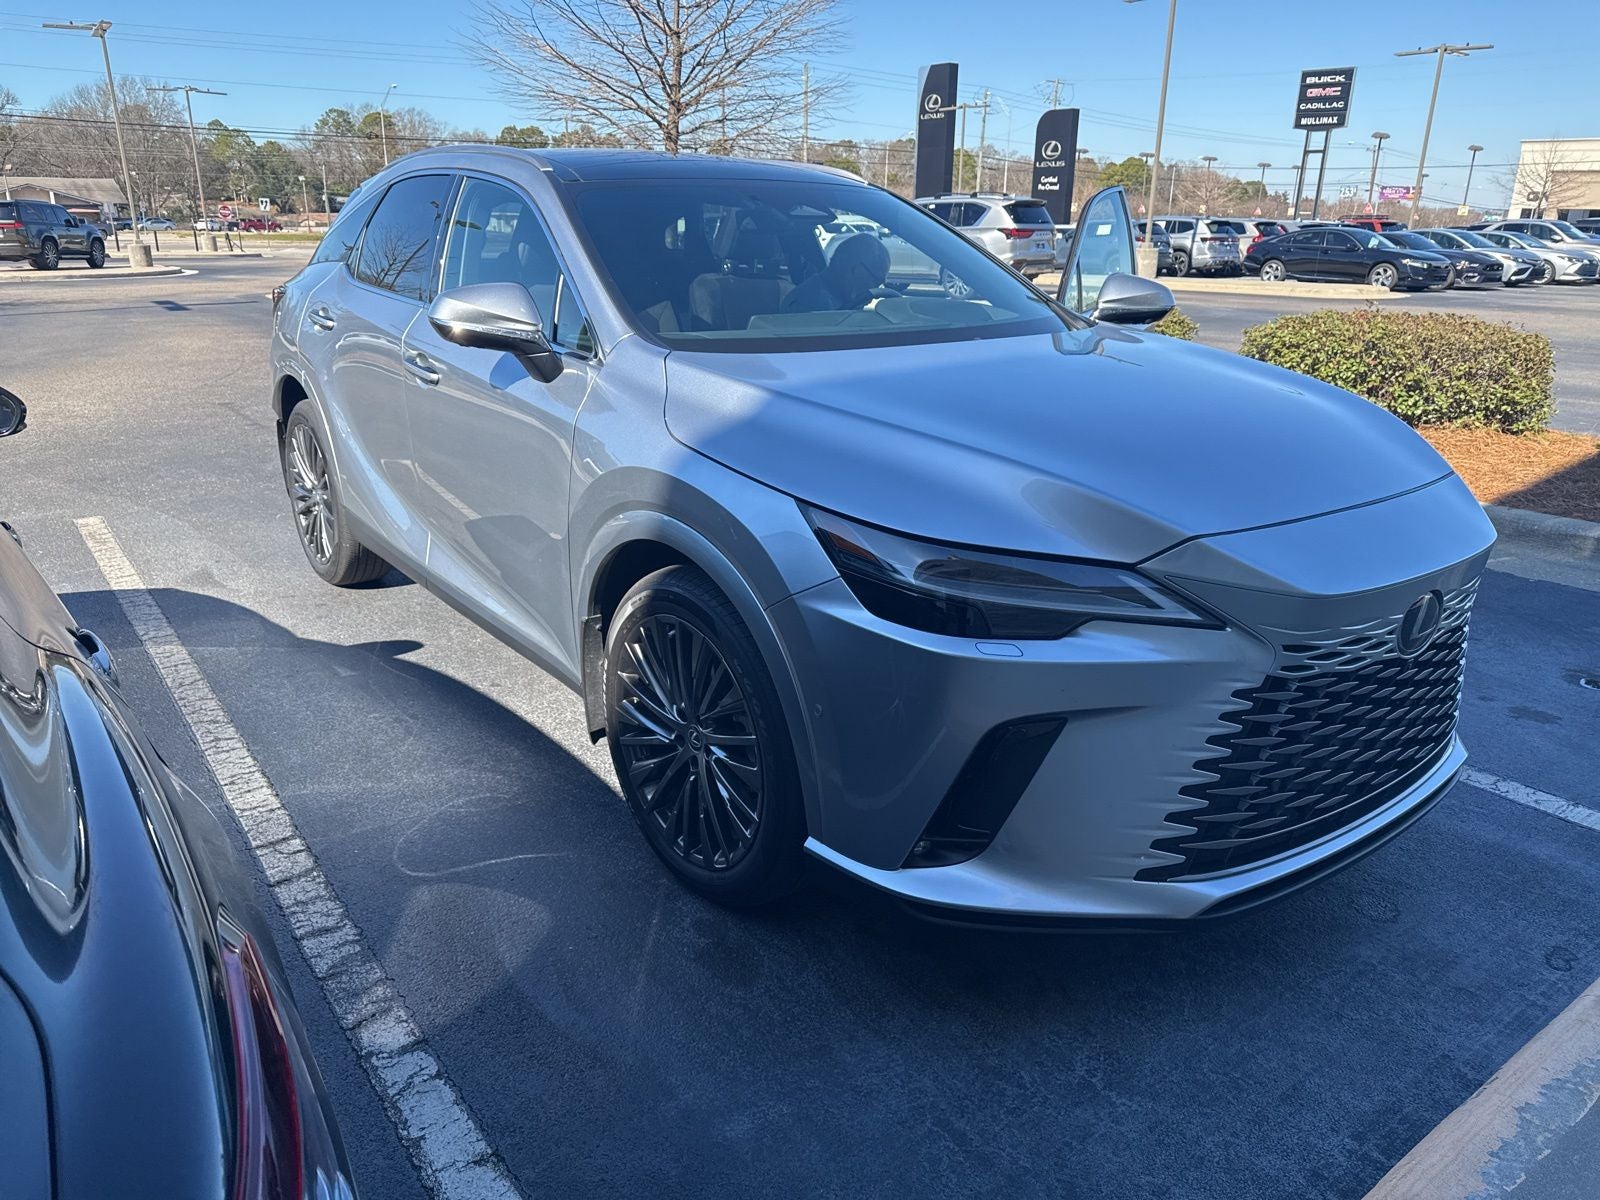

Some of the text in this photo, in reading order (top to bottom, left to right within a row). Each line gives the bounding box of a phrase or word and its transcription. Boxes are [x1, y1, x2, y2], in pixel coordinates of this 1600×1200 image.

[1306, 75, 1346, 83] BUICK
[1306, 87, 1341, 97] GMC
[1300, 101, 1344, 109] CADILLAC
[1300, 116, 1338, 124] MULLINAX
